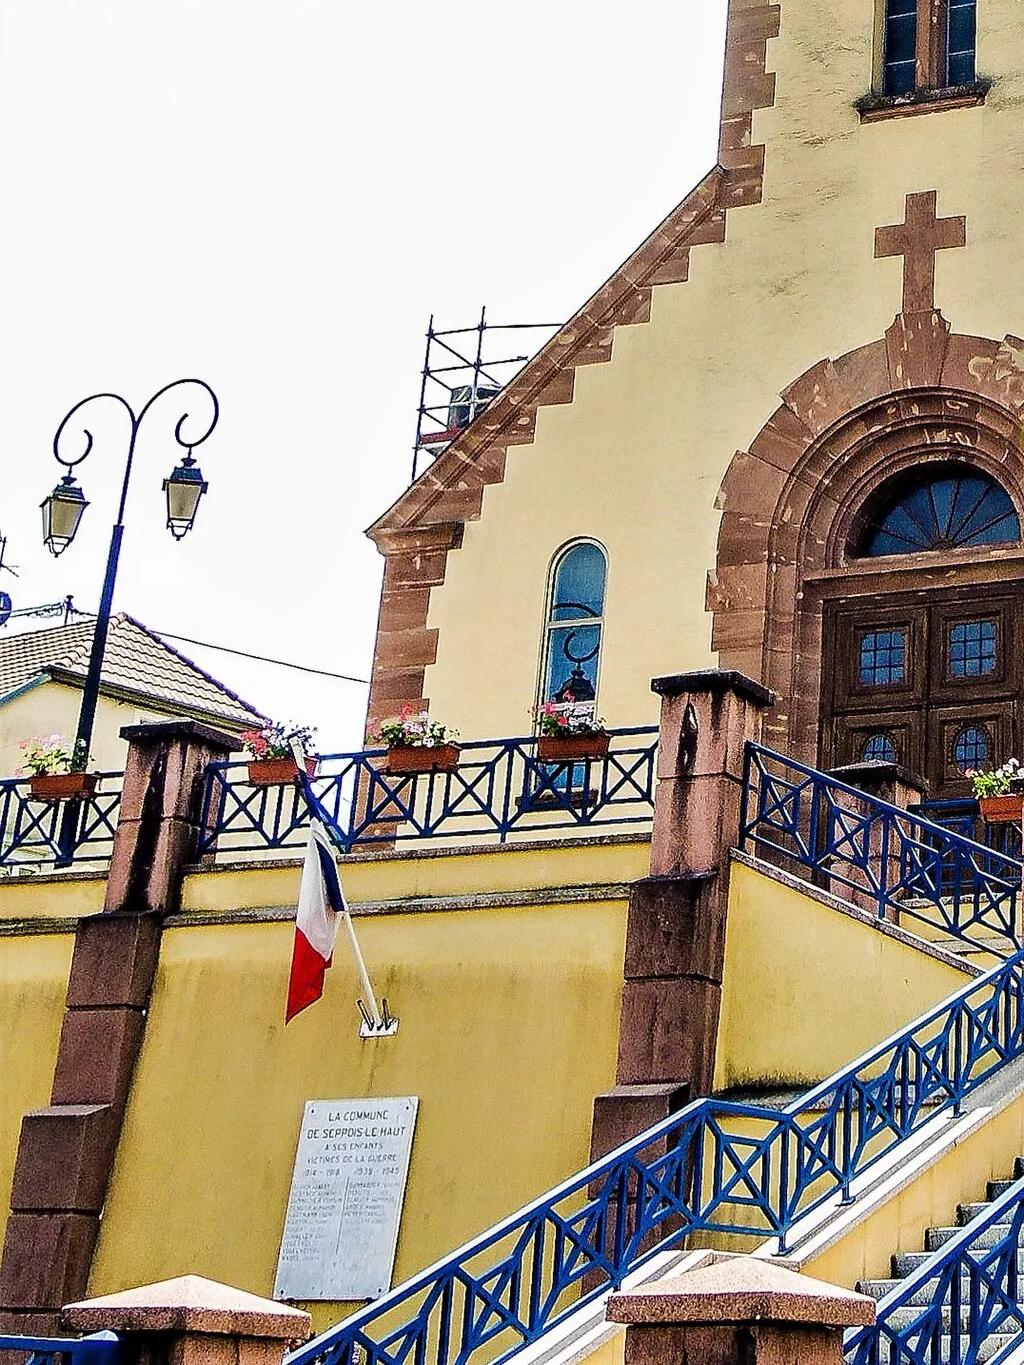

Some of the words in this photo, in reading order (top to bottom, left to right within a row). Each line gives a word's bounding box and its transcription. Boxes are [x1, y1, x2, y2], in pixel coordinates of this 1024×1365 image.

[328, 1112, 341, 1122] LA
[343, 1109, 389, 1121] COMMUNE
[307, 1129, 319, 1139] DE
[332, 1142, 347, 1151] SES
[349, 1142, 384, 1150] ENFANTS
[307, 1155, 340, 1164] VICTIMES
[342, 1155, 353, 1163] DE
[355, 1155, 365, 1163] LA
[367, 1154, 397, 1162] GUERRE
